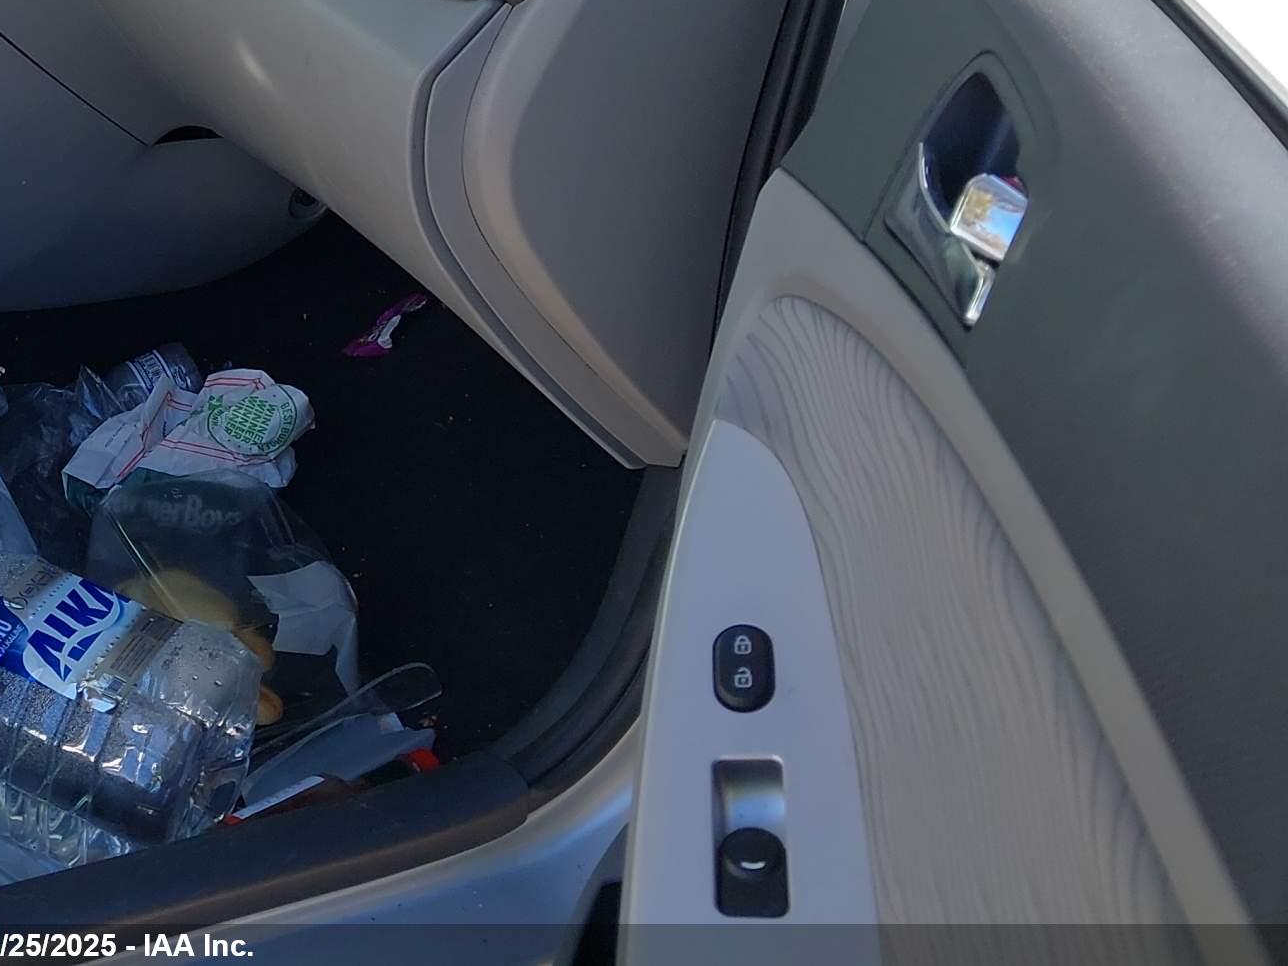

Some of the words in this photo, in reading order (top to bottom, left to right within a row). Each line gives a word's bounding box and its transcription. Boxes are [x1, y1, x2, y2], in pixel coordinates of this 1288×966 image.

[232, 396, 258, 440] WINNER
[241, 399, 268, 444] WINNER
[251, 404, 277, 446] WINNER
[280, 402, 294, 425] BEST
